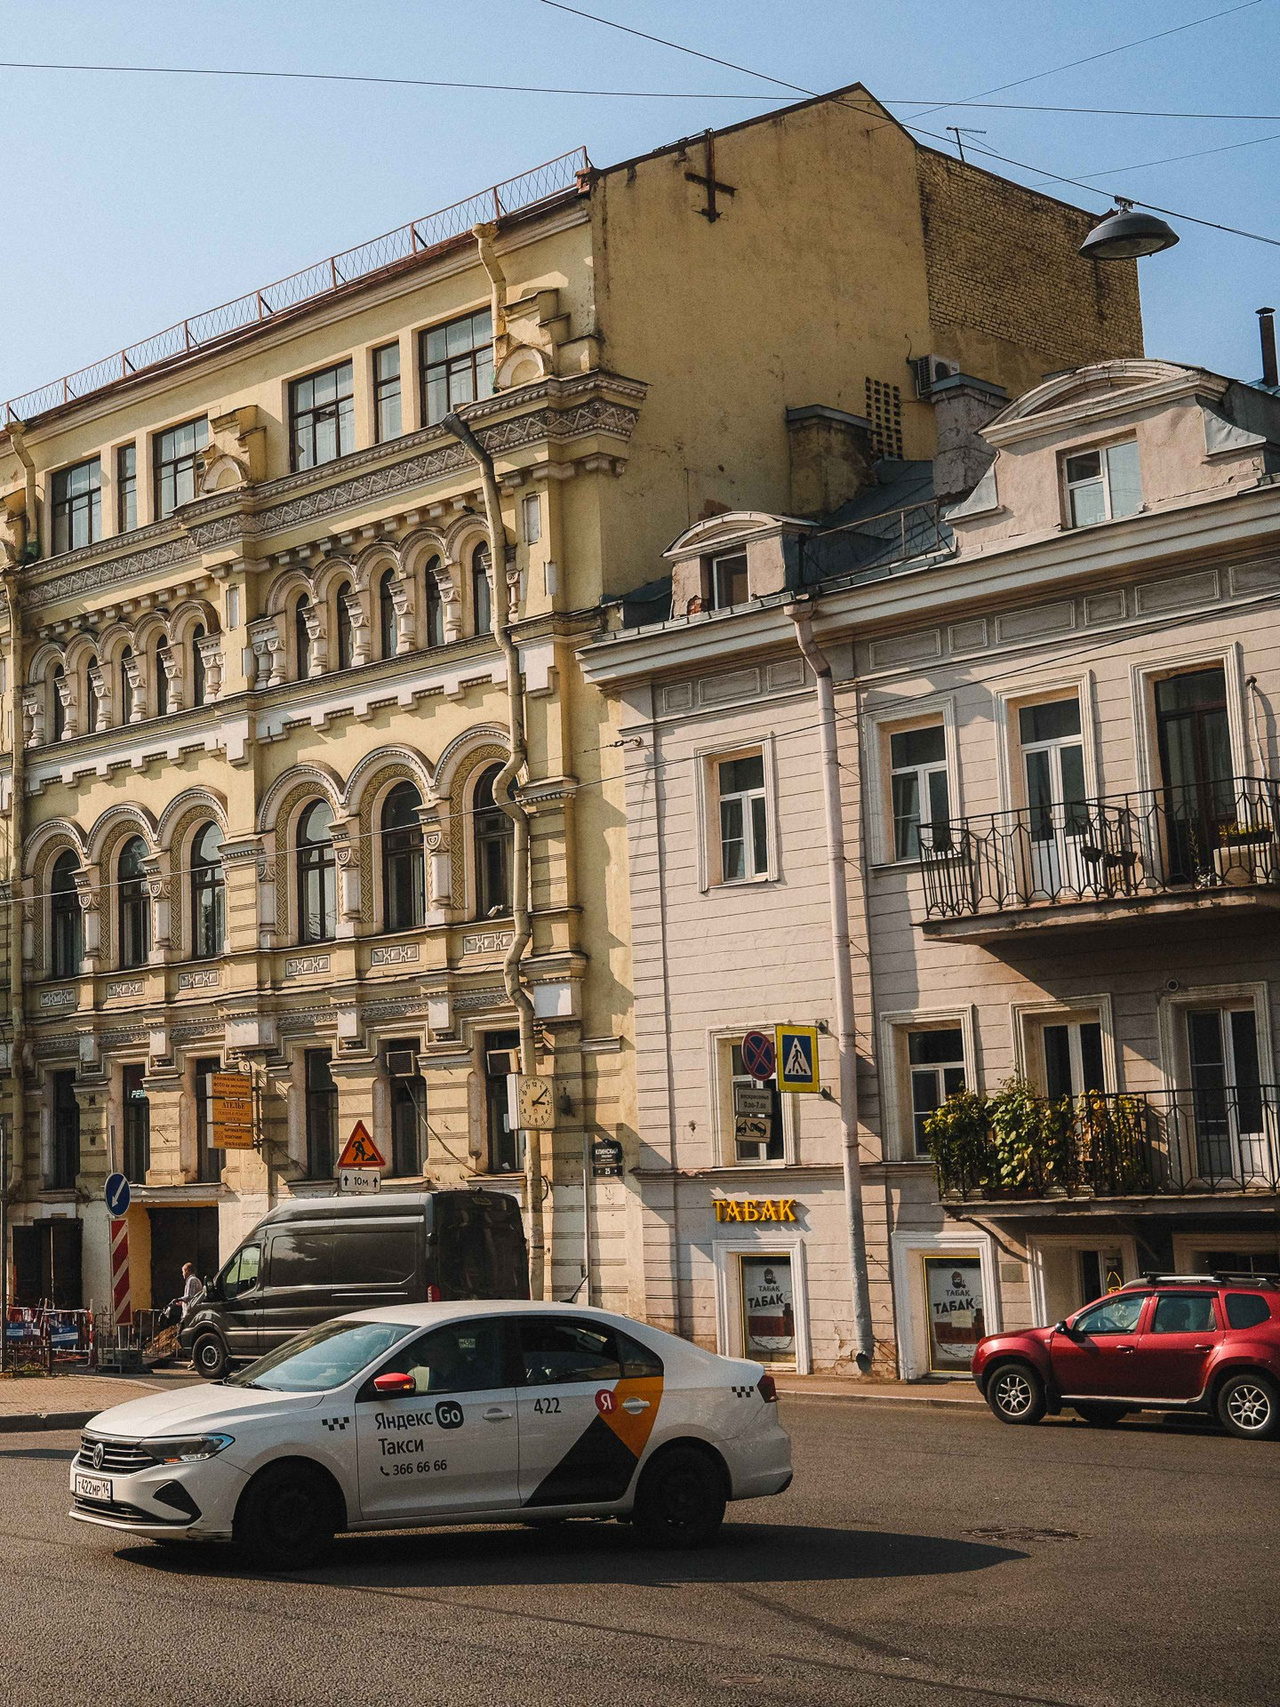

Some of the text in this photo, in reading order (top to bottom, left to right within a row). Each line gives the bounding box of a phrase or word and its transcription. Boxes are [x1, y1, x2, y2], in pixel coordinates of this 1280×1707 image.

[222, 1101, 245, 1110] АТЕЛЬЕ
[711, 1199, 796, 1222] ТАБАК
[748, 1293, 784, 1309] ТАБАК
[945, 1289, 970, 1297] ТАБАК
[933, 1298, 975, 1315] ТАБАК
[534, 1397, 561, 1414] 422
[600, 1393, 612, 1410] Я
[375, 1406, 461, 1431] Яндекс Go
[378, 1438, 424, 1456] Такси
[392, 1459, 447, 1476] 366 66 66
